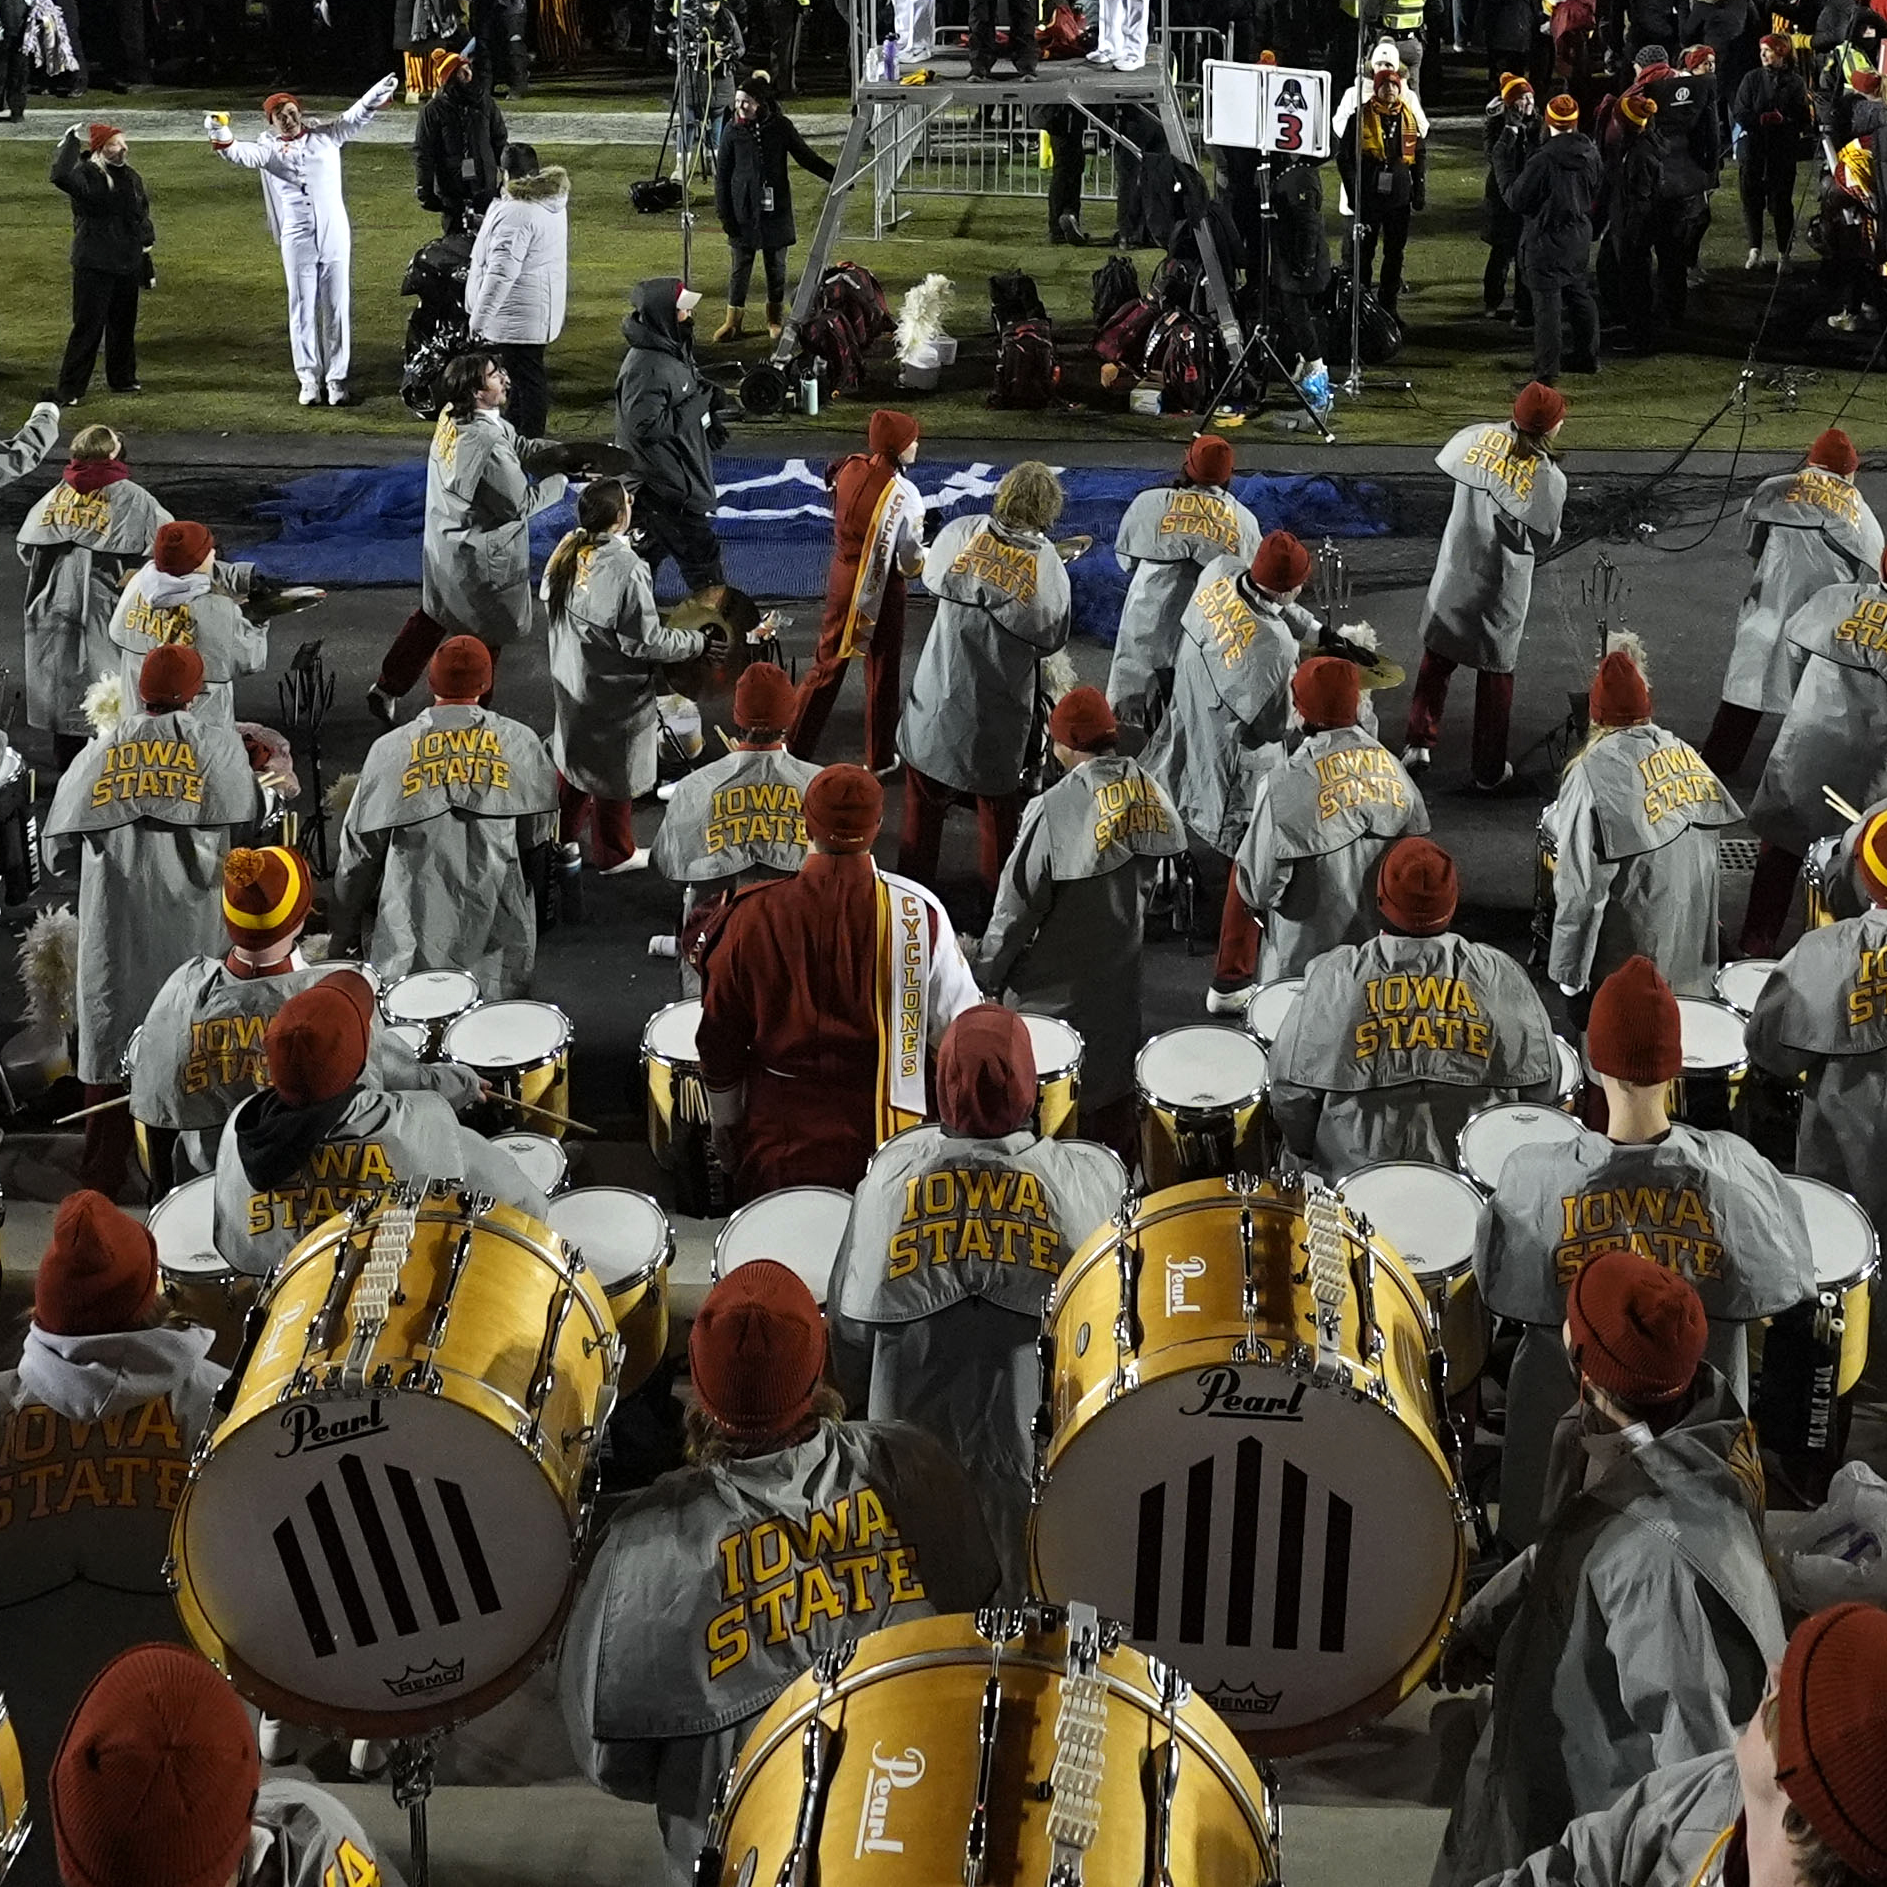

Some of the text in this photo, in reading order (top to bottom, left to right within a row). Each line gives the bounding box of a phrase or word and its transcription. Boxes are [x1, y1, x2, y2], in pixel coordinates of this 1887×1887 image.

[1275, 113, 1303, 151] 3
[1463, 446, 1533, 502] STATE
[1798, 470, 1858, 501] IOWA
[39, 505, 111, 536] STATE
[1169, 492, 1237, 527] IOWA
[1785, 484, 1863, 528] STATE
[966, 532, 1039, 583] IOWA
[1159, 515, 1238, 556] STATE
[949, 552, 1037, 609] STATE
[1193, 588, 1242, 669] STATE
[1215, 575, 1257, 645] IOWA
[105, 739, 199, 775] IOWA
[411, 727, 502, 760] IOWA
[1315, 746, 1399, 782] IOWA
[1637, 744, 1708, 782] IOWA
[91, 768, 204, 809] STATE
[401, 752, 510, 798] STATE
[1093, 769, 1159, 811] IOWA
[712, 782, 804, 818] IOWA
[1318, 776, 1406, 821] STATE
[1643, 772, 1724, 825] STATE
[705, 812, 808, 856] STATE
[1093, 804, 1168, 853] STATE
[900, 895, 919, 1077] CYCLONES
[1366, 976, 1480, 1020] IOWA
[190, 1016, 275, 1060] IOW
[1354, 1015, 1490, 1062] STATE
[183, 1050, 273, 1096] STA
[313, 1141, 396, 1187] OWA
[901, 1167, 1050, 1226] IOWA
[1559, 1189, 1713, 1242] IOWA
[889, 1217, 1060, 1282] STATE
[1164, 1254, 1202, 1318] Pearl
[1178, 1367, 1309, 1421] Pearl
[276, 1398, 391, 1460] Pearl
[719, 1486, 901, 1587] IOWA
[707, 1551, 928, 1681] STATE
[397, 1668, 461, 1696] REMO
[857, 1741, 929, 1859] Pearl
